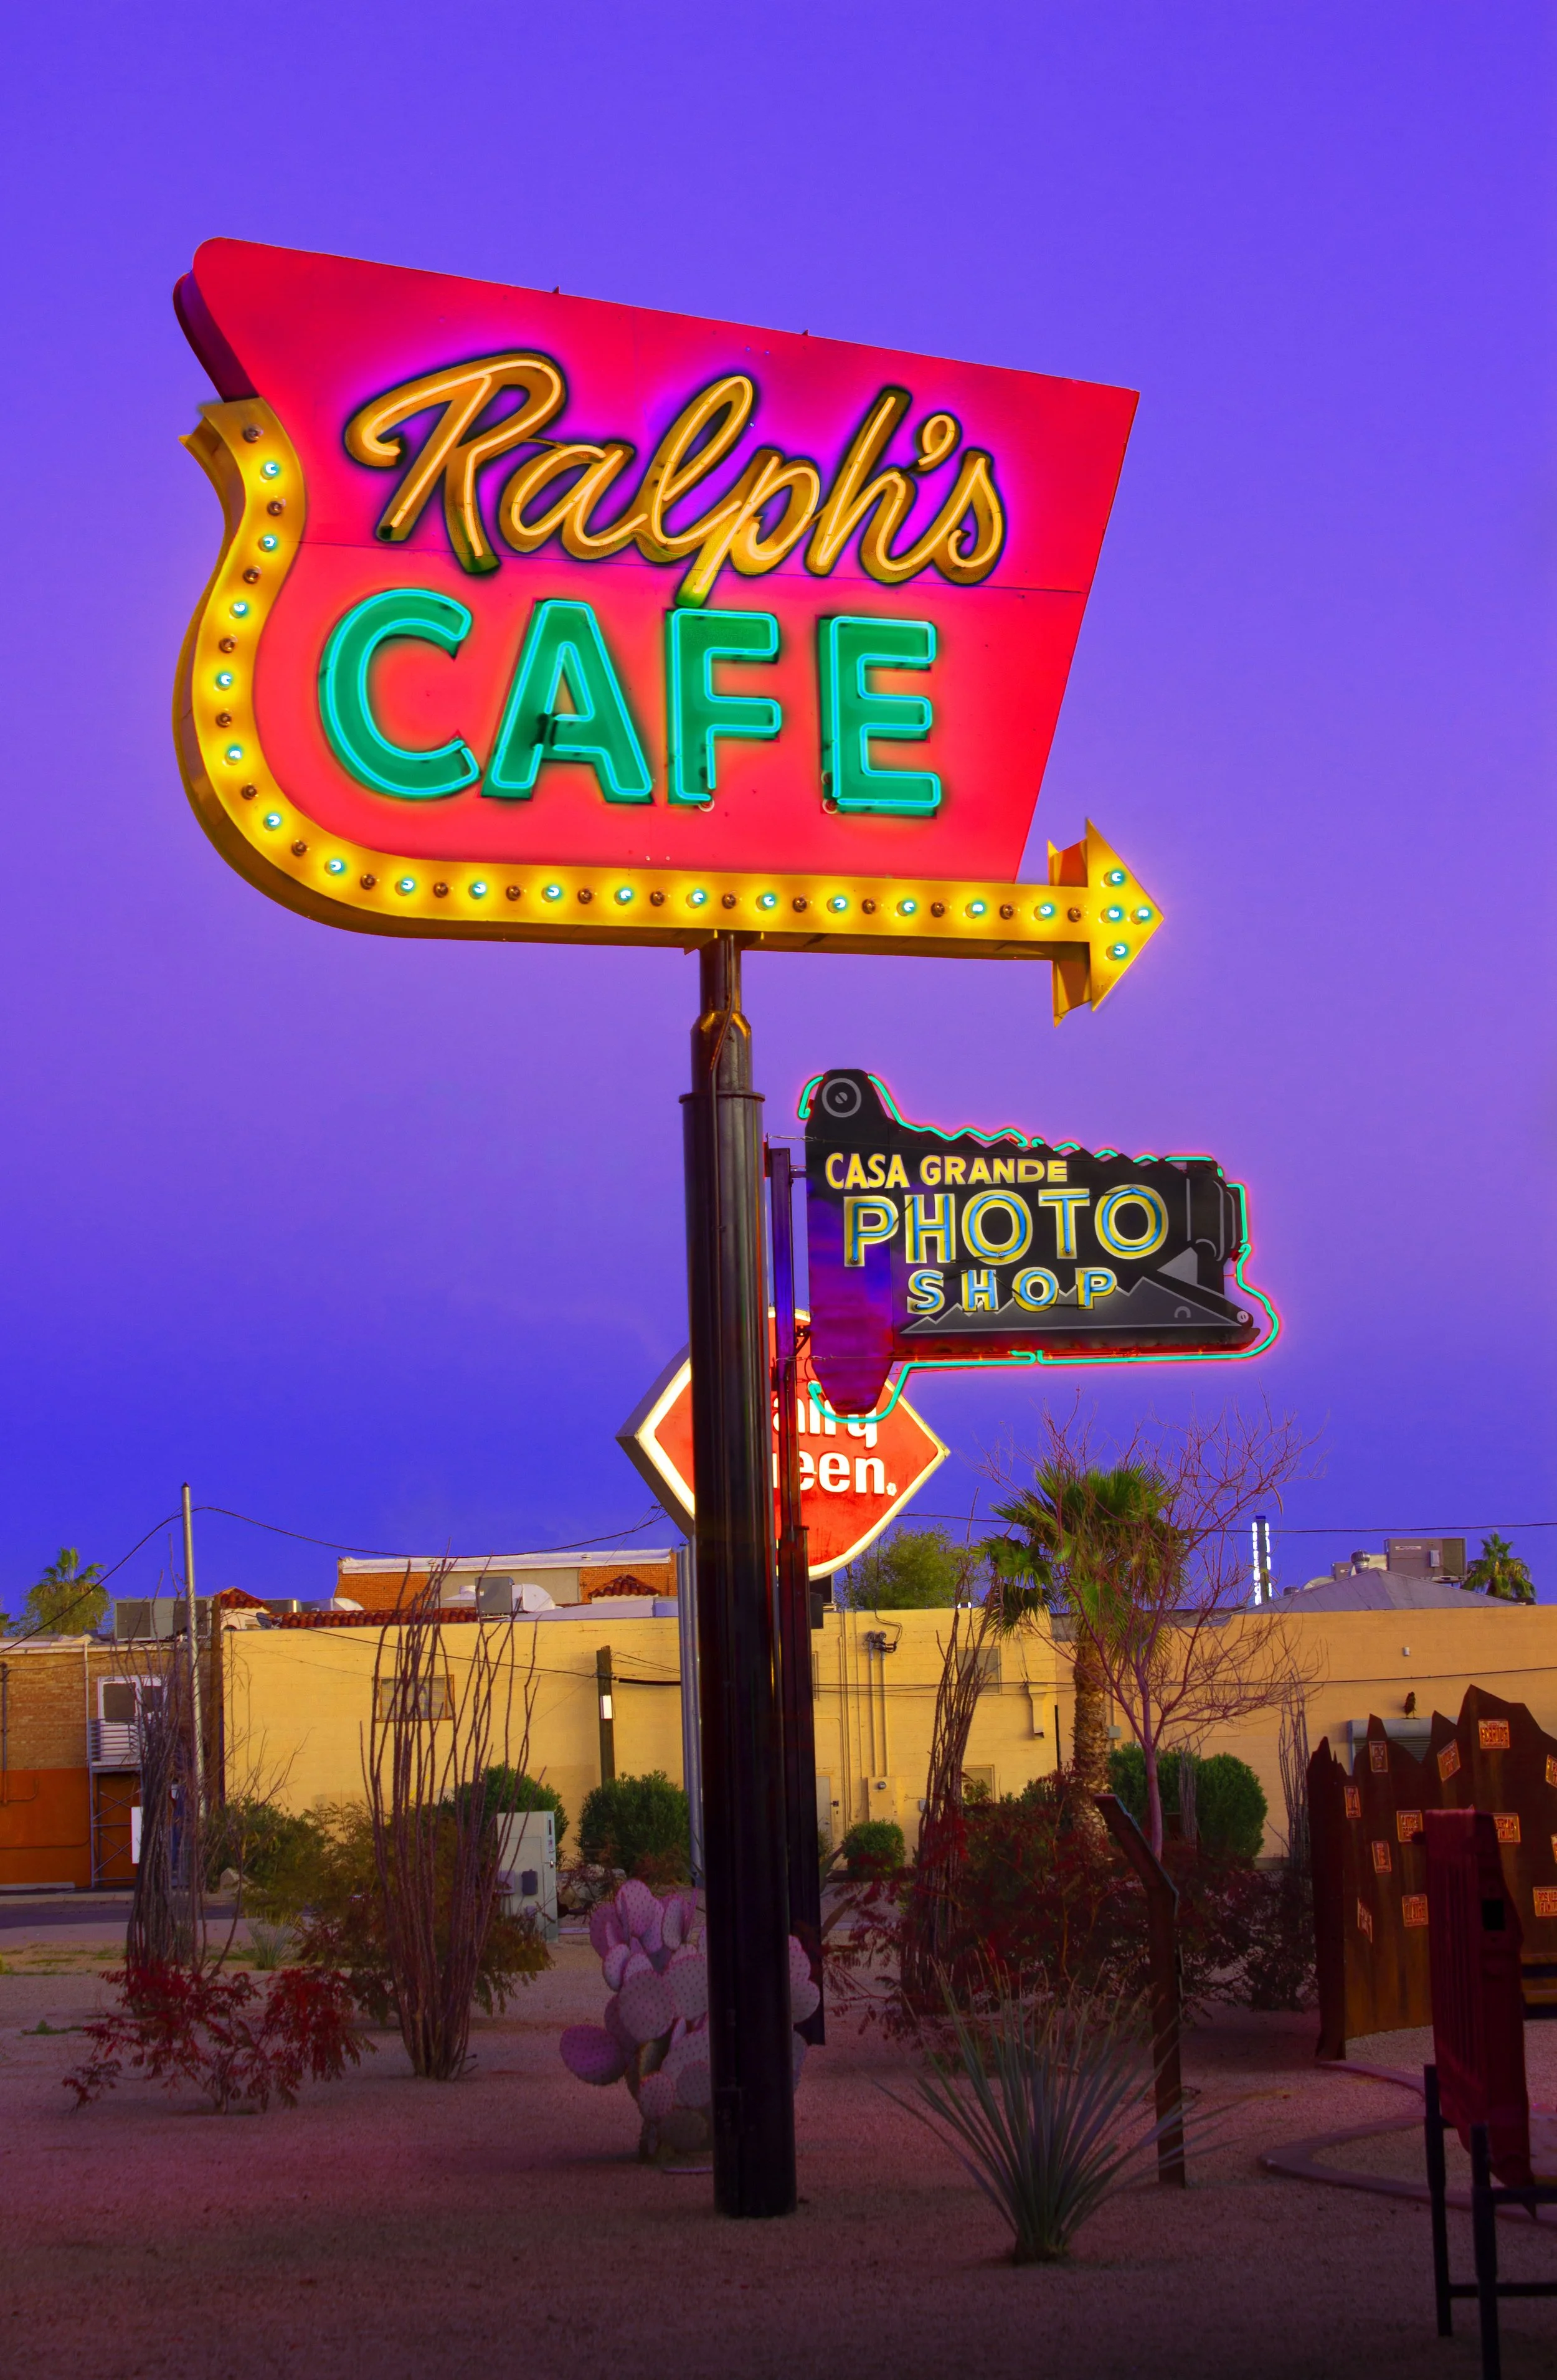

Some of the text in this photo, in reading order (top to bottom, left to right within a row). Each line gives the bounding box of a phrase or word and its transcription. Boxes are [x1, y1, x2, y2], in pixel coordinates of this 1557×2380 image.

[344, 350, 1006, 607] Ralph's
[318, 588, 943, 816] CAFE
[825, 1152, 1068, 1190] CASA GRANDE
[843, 1184, 1169, 1268] PHOTO
[907, 1268, 1119, 1314] SHOP
